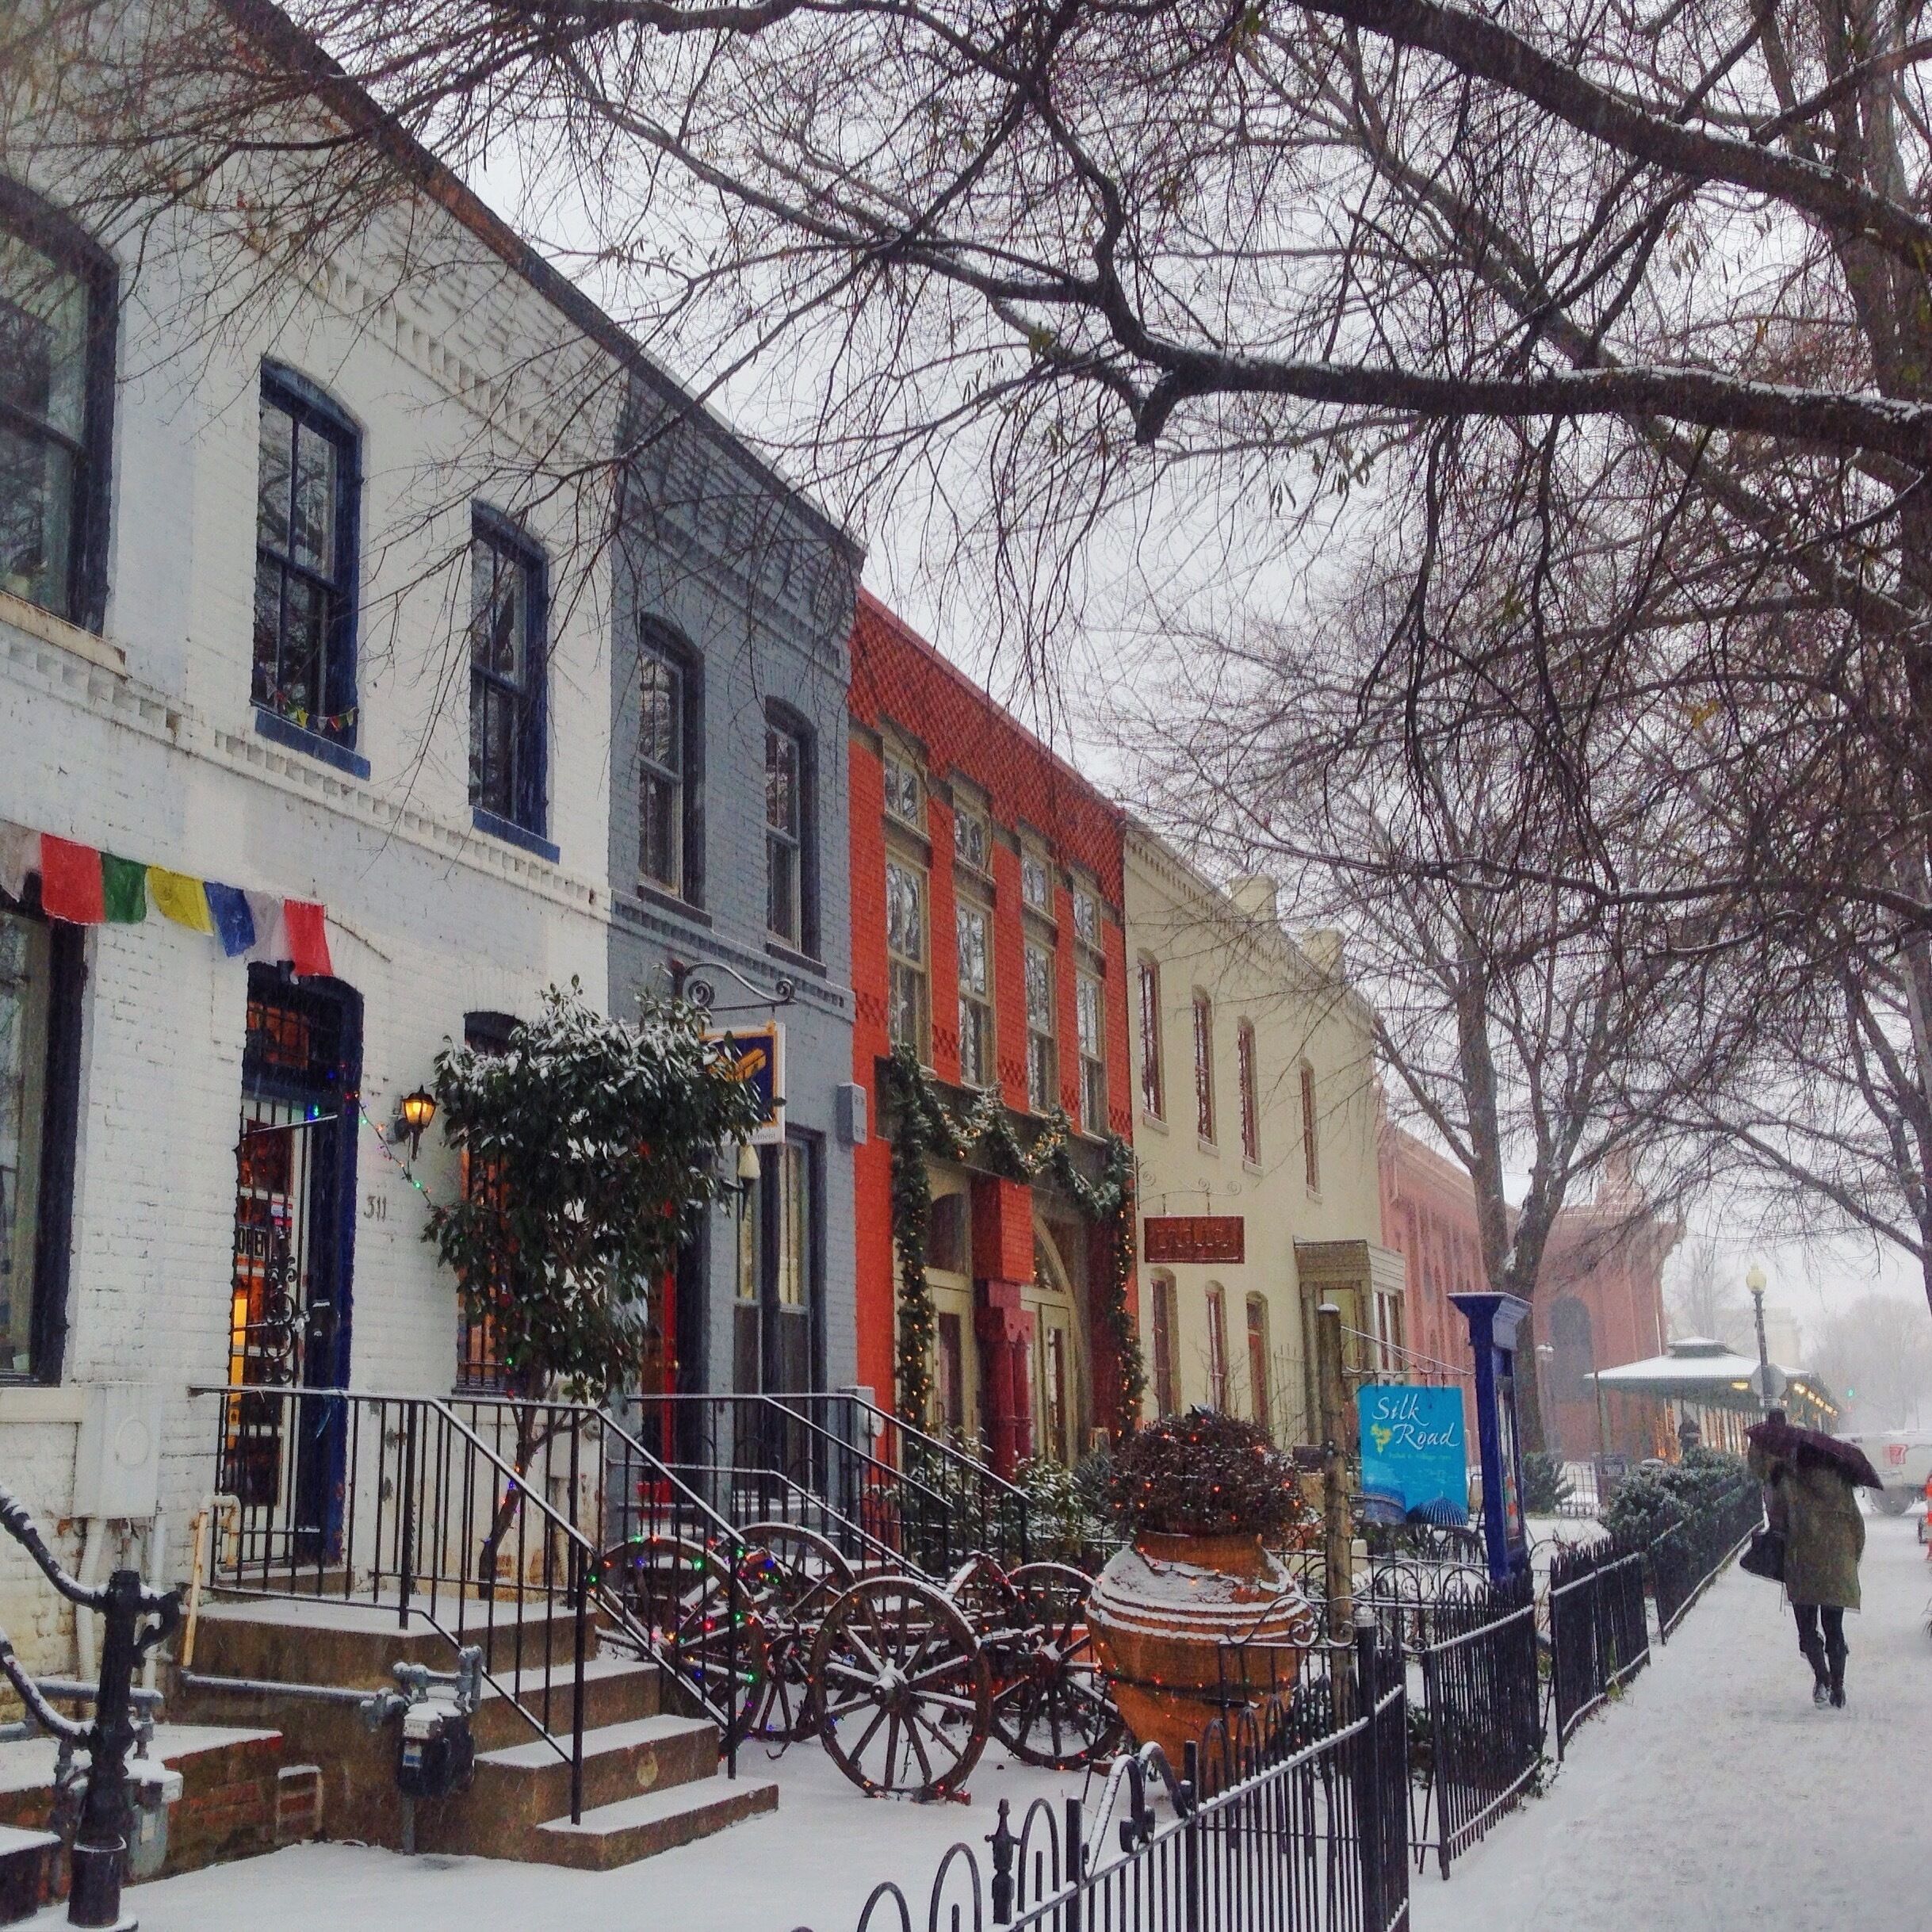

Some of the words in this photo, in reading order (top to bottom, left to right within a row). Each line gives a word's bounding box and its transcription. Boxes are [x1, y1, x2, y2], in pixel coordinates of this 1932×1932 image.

[364, 1195, 387, 1222] 311
[1372, 1393, 1429, 1426] Silk
[1392, 1421, 1460, 1450] Road
